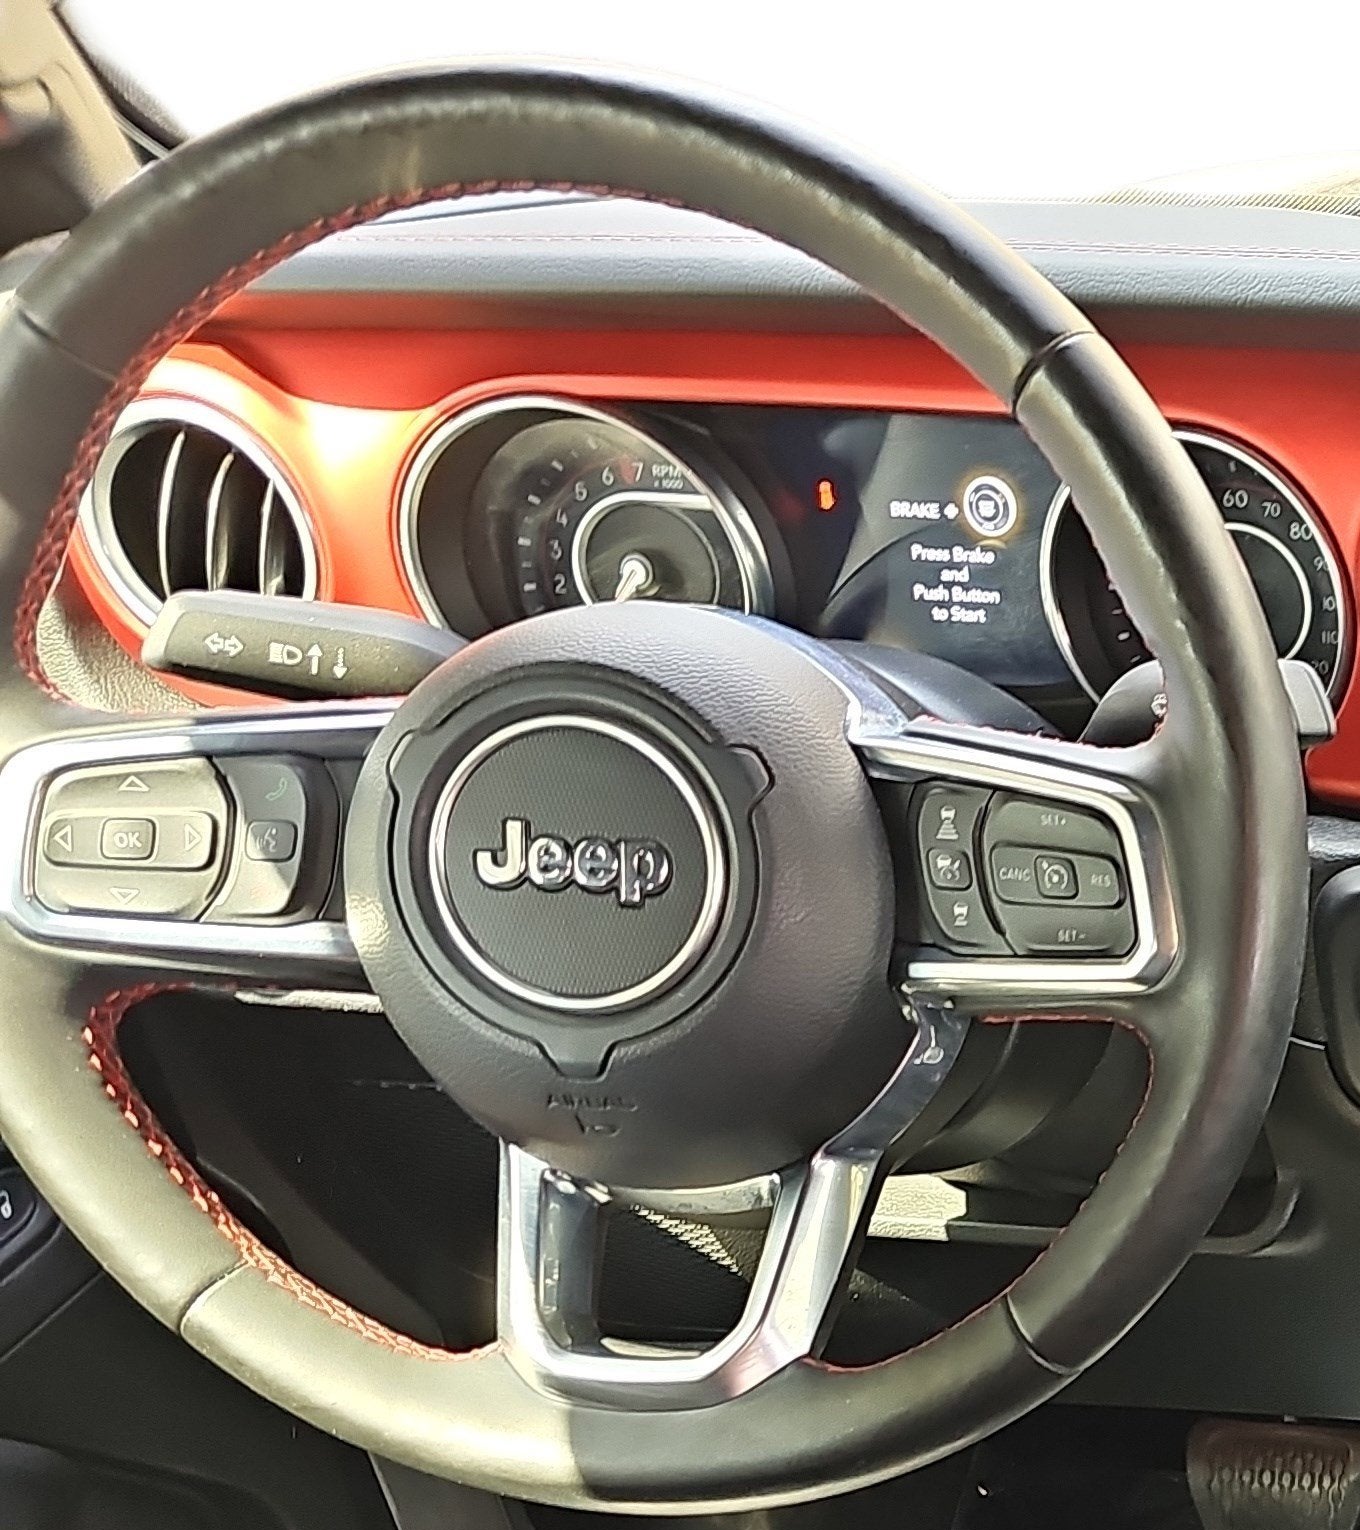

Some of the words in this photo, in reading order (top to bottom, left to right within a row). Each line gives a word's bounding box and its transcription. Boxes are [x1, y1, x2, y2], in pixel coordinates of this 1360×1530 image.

[601, 466, 614, 486] 6
[632, 461, 645, 483] 7
[1222, 489, 1249, 508] 60
[555, 507, 568, 528] 4
[889, 500, 941, 519] BRAKE
[1261, 501, 1282, 518] 70
[1288, 521, 1314, 541] 80
[550, 539, 562, 560] 3
[910, 543, 950, 562] Press
[952, 545, 996, 564] Brake
[940, 565, 970, 582] and
[553, 573, 568, 595] 2
[913, 583, 949, 601] Push
[951, 585, 1001, 604] Button
[931, 606, 949, 621] to
[950, 605, 987, 623] Start
[113, 831, 142, 849] OK
[473, 816, 675, 907] Jeep
[999, 866, 1031, 882] CANC
